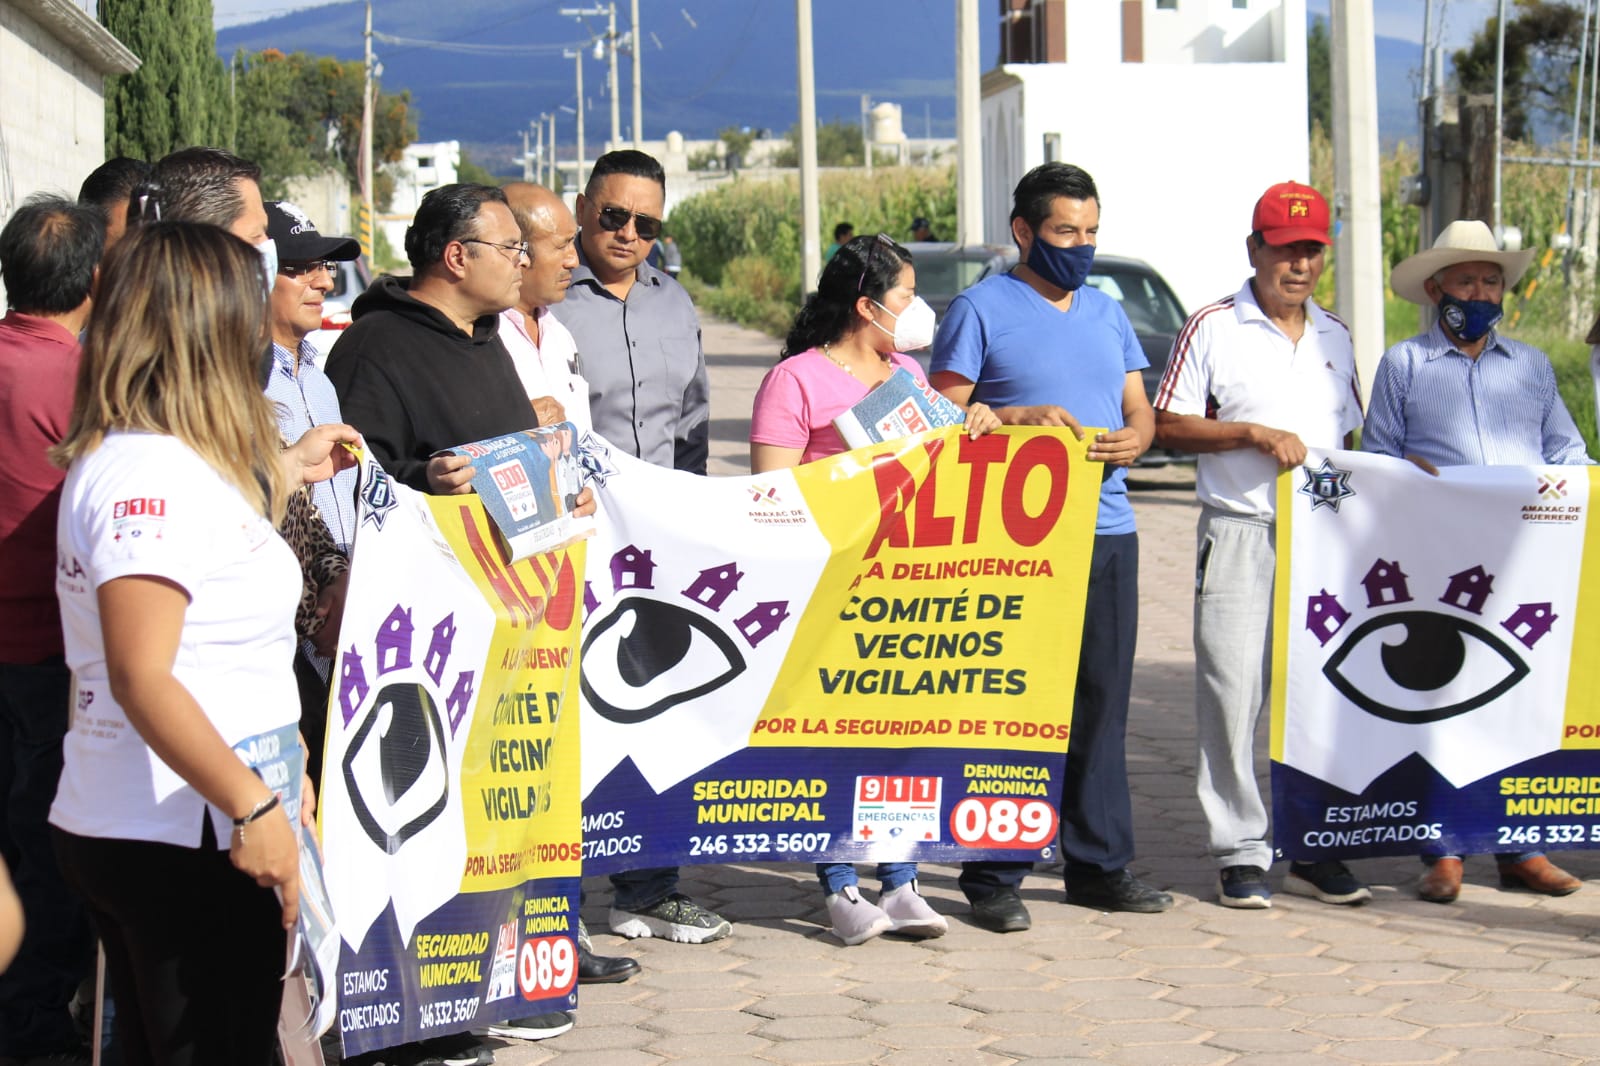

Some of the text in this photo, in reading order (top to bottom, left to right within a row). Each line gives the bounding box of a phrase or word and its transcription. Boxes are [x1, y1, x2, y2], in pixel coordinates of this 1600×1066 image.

[113, 498, 165, 519] 911
[862, 433, 1069, 562] ALTO
[1520, 504, 1582, 513] AMAXAC DE
[1521, 512, 1579, 522] GUERRERO
[891, 558, 1054, 581] DELINCUENCIA
[839, 588, 1024, 623] COMITÉ DE
[854, 631, 1004, 659] VECINOS
[818, 668, 1027, 695] VIGILANTES
[753, 717, 1070, 740] POR LA SEGURIDAD DE TODOS
[963, 764, 1051, 781] DENUNCIA
[693, 779, 828, 801] SEGURIDAD
[863, 777, 934, 800] 911
[966, 780, 1048, 796] ANONIMA
[697, 802, 826, 824] MUNICIPAL
[857, 812, 936, 822] EMERGENCIAS
[954, 799, 1053, 843] 089
[1325, 801, 1418, 823] ESTAMOS
[689, 833, 832, 856] 246 332 5607
[1303, 823, 1443, 848] CONECTADOS
[1497, 825, 1541, 844] 246
[1545, 824, 1586, 843] 332
[464, 855, 485, 877] POR
[537, 842, 581, 863] TODOS
[524, 896, 570, 915] DENUNCIA
[525, 915, 569, 934] ANONIMA
[416, 932, 489, 959] SEGURIDAD
[420, 960, 482, 989] MUNICIPAL
[519, 938, 575, 993] 089
[343, 968, 390, 995] ESTAMOS
[340, 1002, 400, 1033] CONECTADOS
[419, 997, 480, 1029] 246 332 5607
